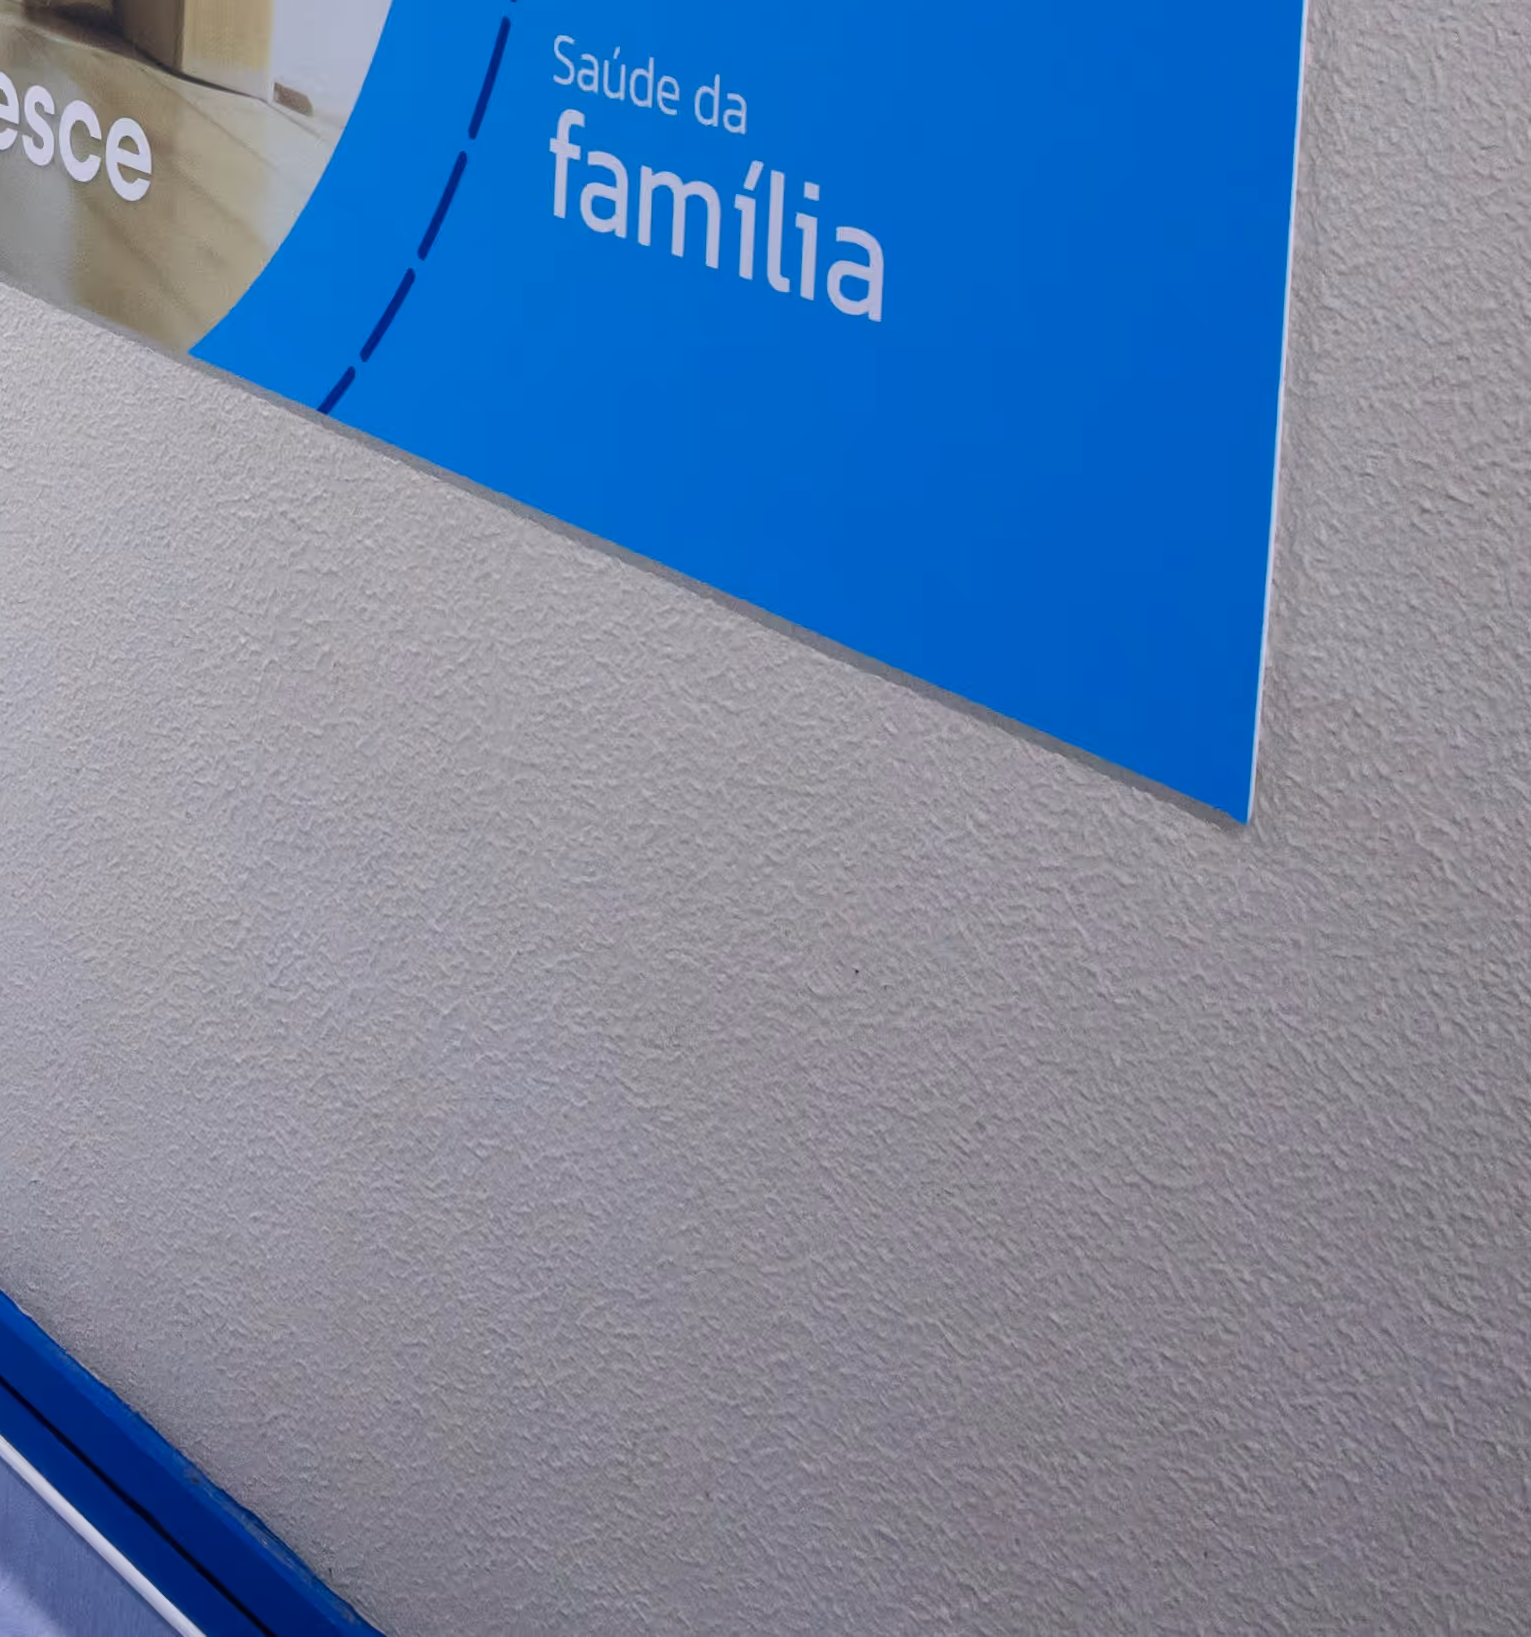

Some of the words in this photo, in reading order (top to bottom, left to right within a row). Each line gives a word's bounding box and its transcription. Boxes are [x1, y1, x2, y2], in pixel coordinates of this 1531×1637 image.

[552, 35, 680, 116] Saúde
[694, 74, 747, 134] da
[549, 108, 884, 322] família
